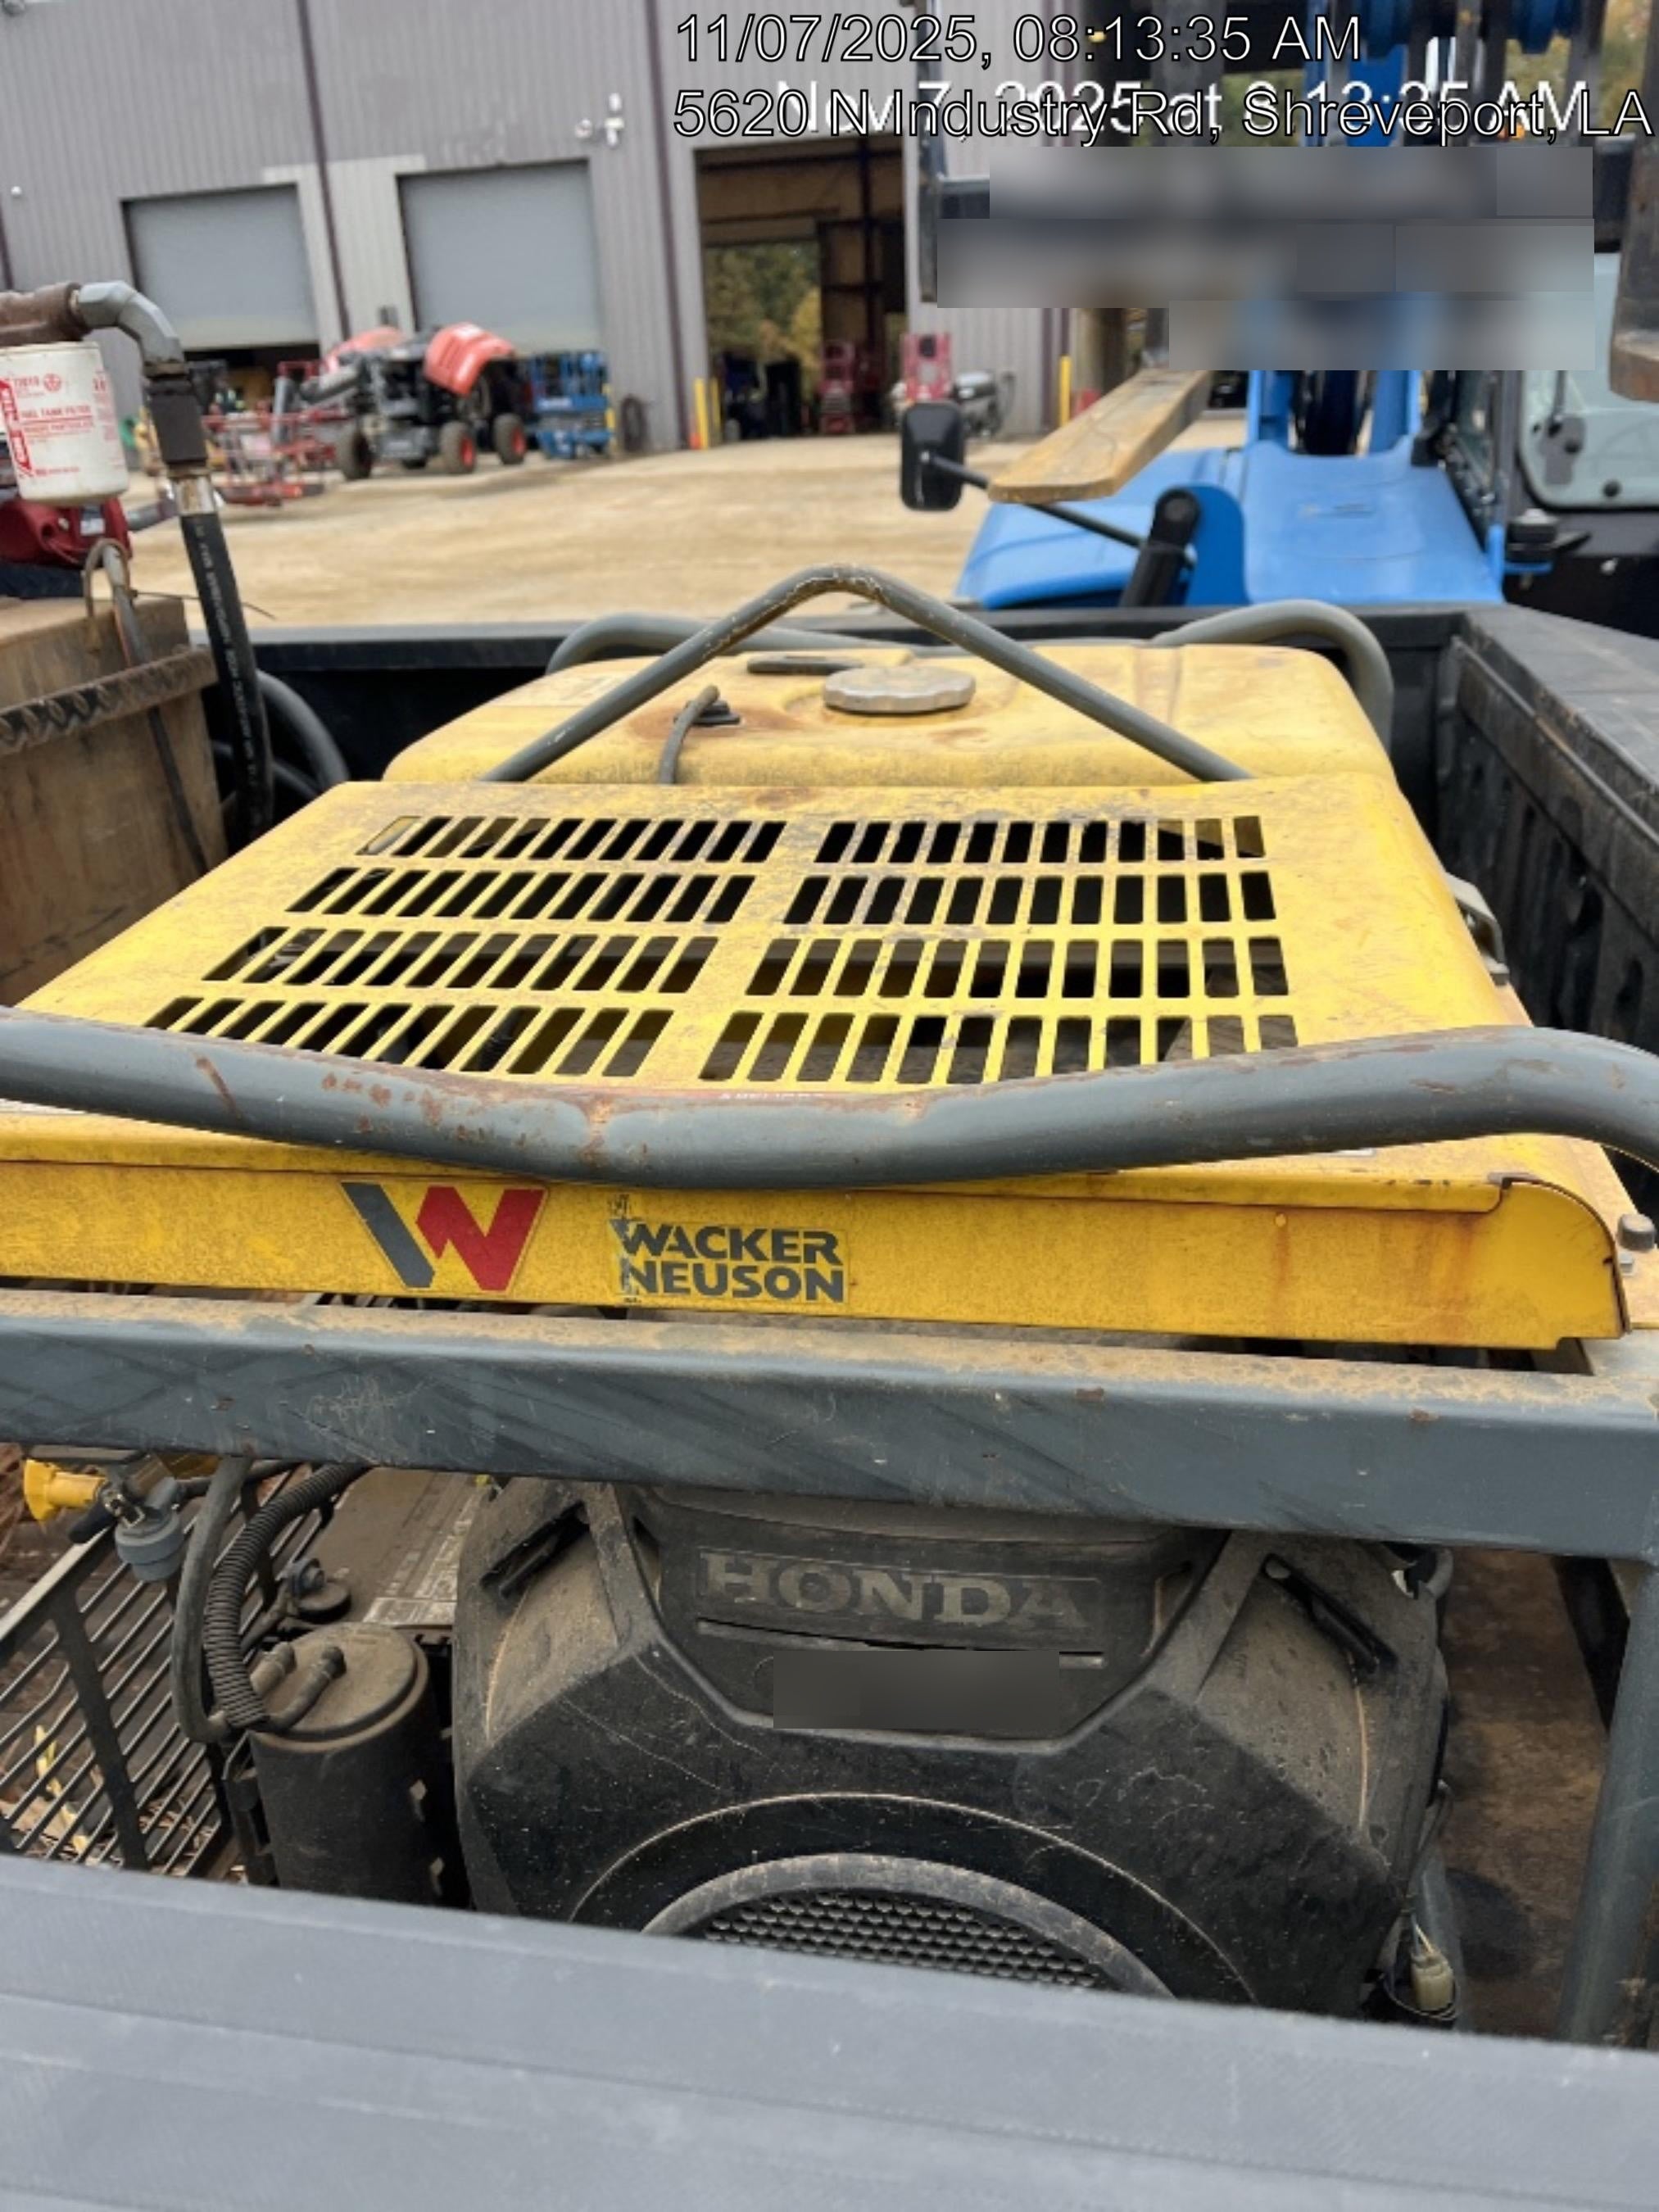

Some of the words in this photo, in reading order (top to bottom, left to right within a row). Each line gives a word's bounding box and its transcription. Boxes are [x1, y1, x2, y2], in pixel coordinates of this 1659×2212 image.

[610, 1218, 843, 1266] WACKER
[620, 1258, 844, 1303] NEUSON
[700, 1552, 1090, 1630] HONDA
